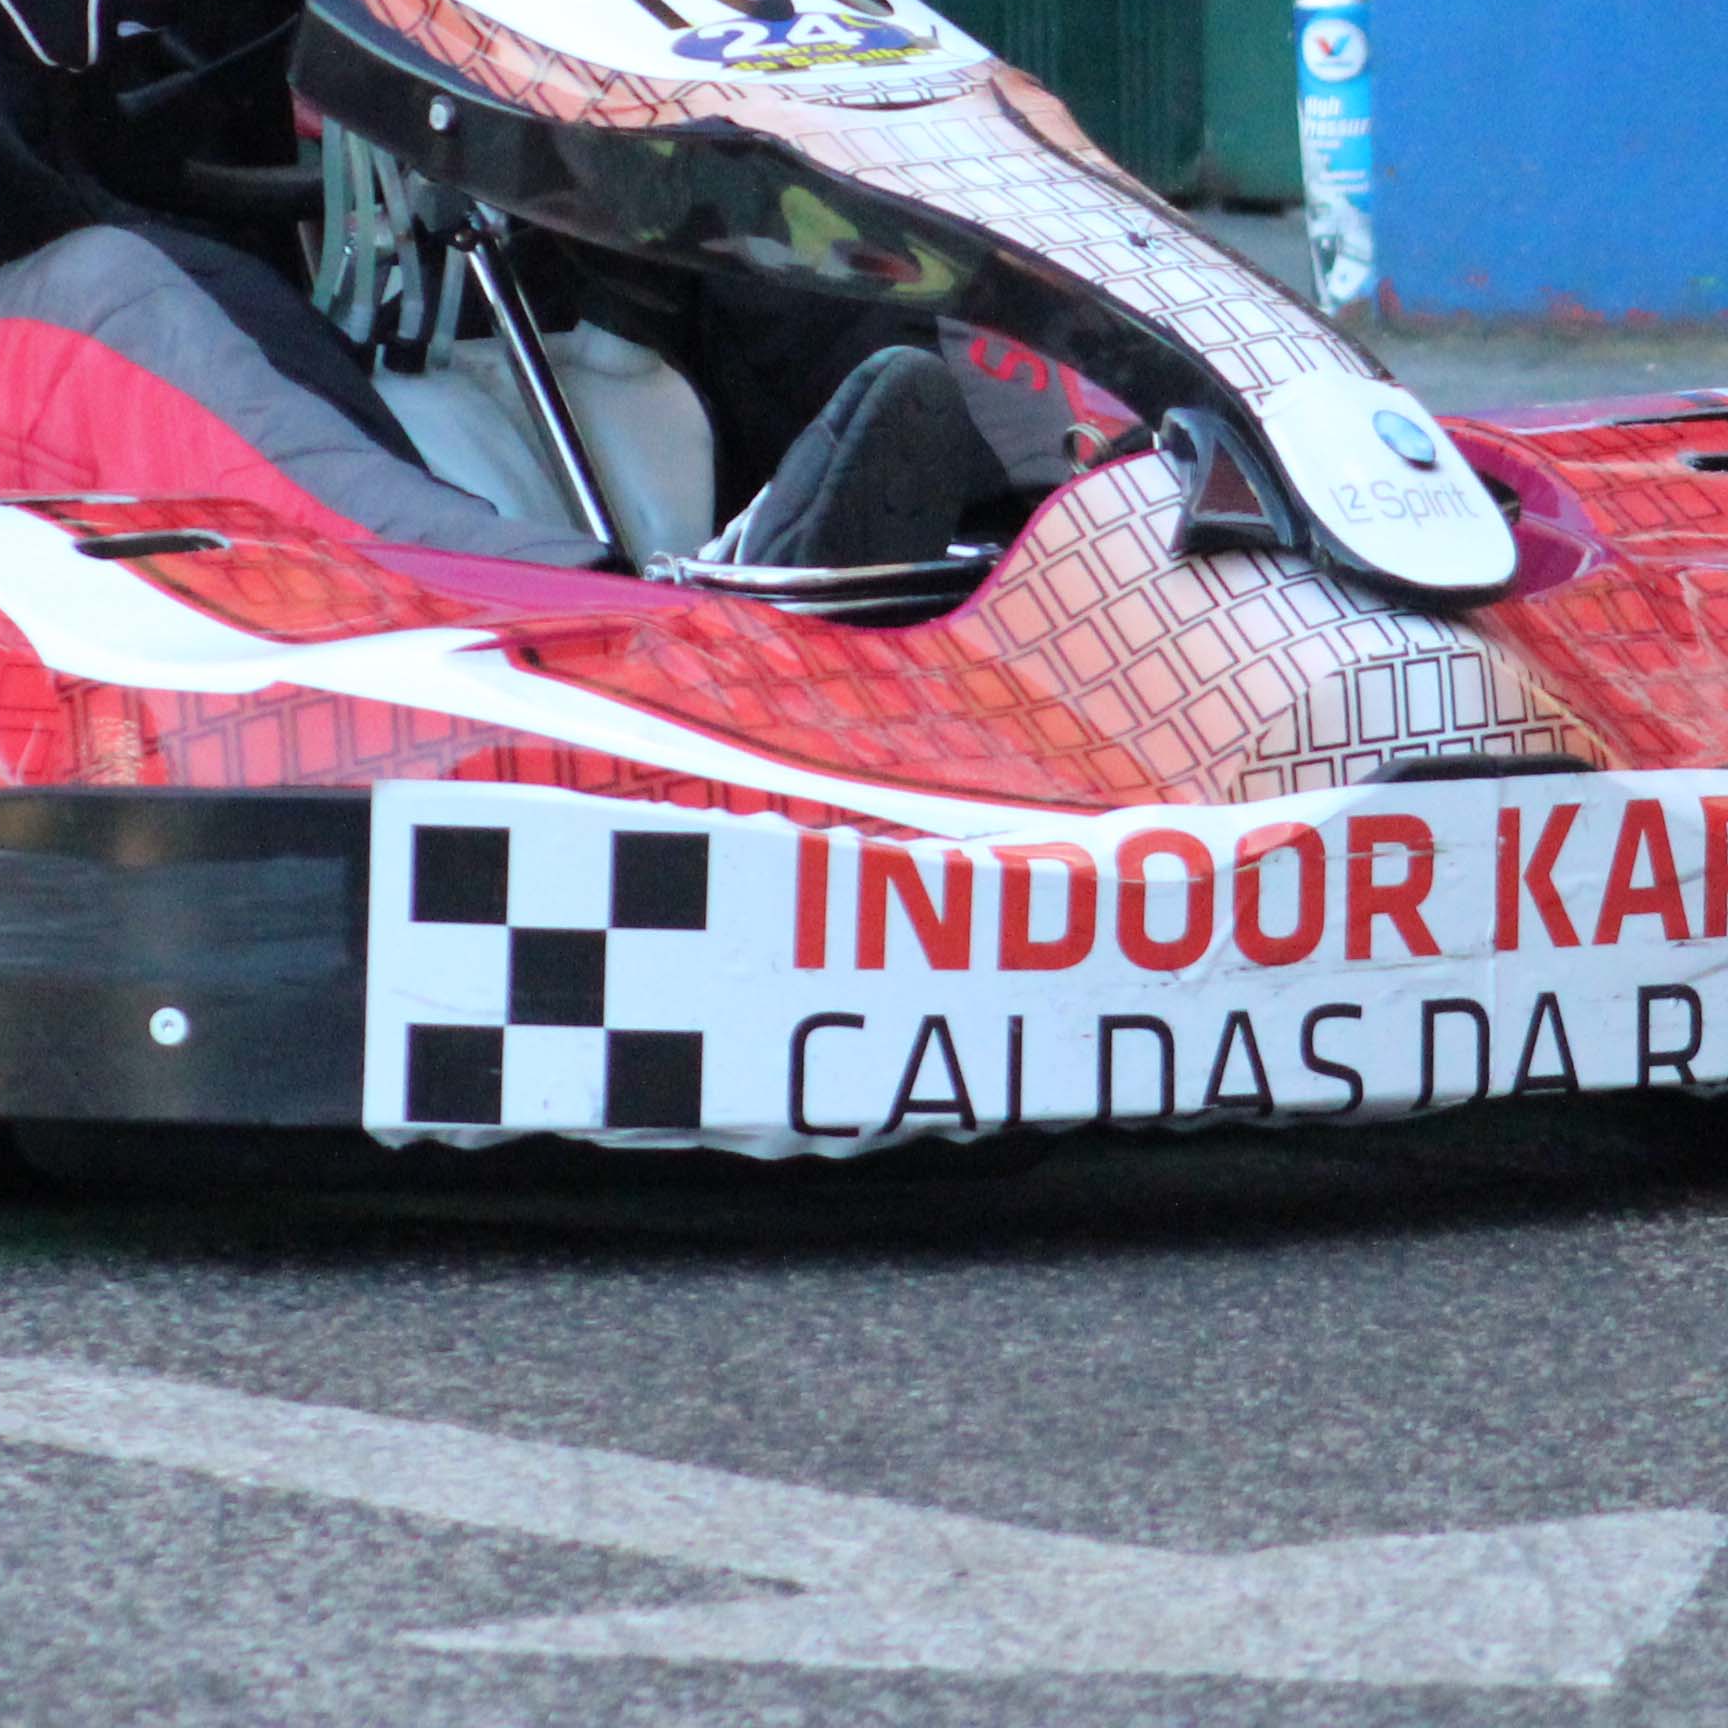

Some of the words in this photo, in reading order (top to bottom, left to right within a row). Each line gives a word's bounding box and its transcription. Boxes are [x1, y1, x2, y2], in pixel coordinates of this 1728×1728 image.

[696, 13, 865, 59] 24
[1372, 479, 1482, 528] Spirit
[793, 811, 1442, 972] INDOOR
[789, 1001, 1365, 1138] CALDAS
[1419, 990, 1582, 1110] DA
